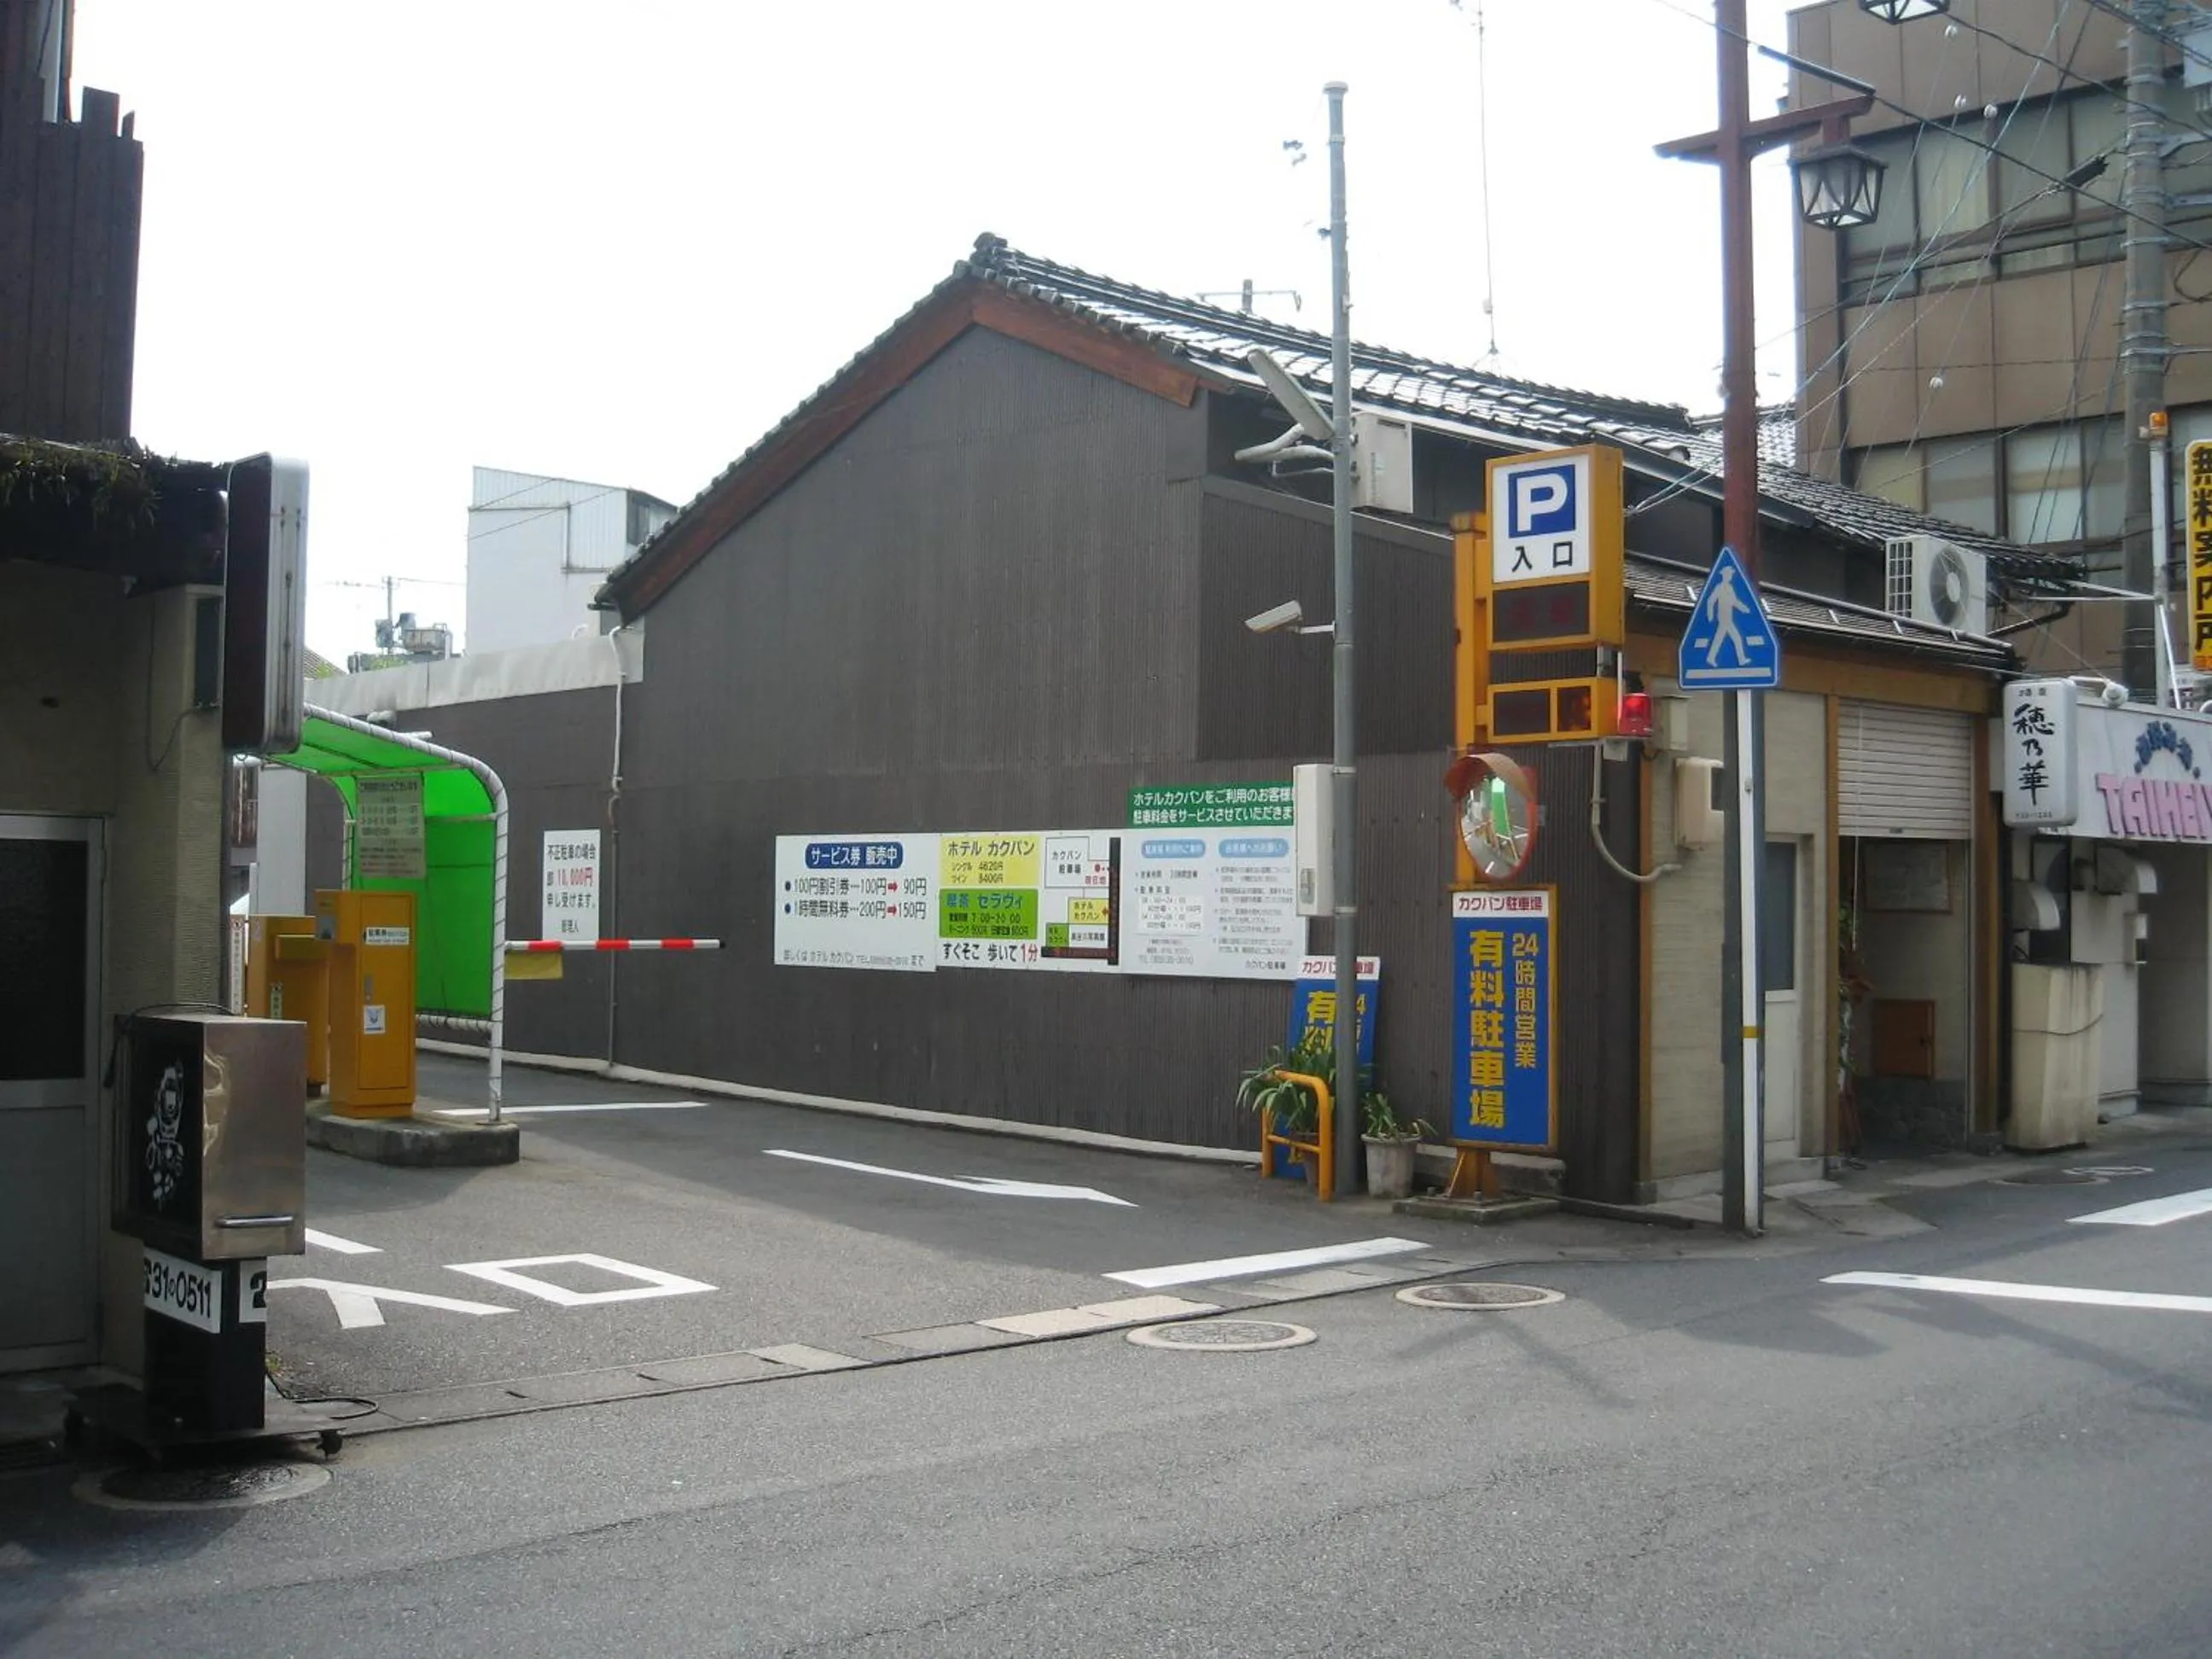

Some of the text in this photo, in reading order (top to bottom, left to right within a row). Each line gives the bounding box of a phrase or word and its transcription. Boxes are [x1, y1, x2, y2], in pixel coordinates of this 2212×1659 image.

[1516, 473, 1569, 533] P
[1511, 540, 1573, 573] 入口
[1133, 787, 1294, 806] ホテルカクバンをご利用のお客様
[547, 843, 596, 860] 不正駐車の場合
[811, 846, 898, 865] サービス券 販売中
[948, 841, 1035, 858] ホテル カクバン
[1051, 850, 1082, 861] カクバン
[951, 862, 973, 871] シングル
[1058, 864, 1081, 874] 駐車場
[903, 876, 927, 896] 90円
[951, 875, 968, 884] ツイン
[899, 901, 927, 920] 150円
[947, 894, 1022, 909] 喫茶 セラヴィ
[1074, 901, 1093, 911] ホテル
[1458, 895, 1543, 913] カクバン駐車場
[943, 943, 1039, 963] すぐそこ 歩いて1分
[1512, 932, 1540, 1069] 24時間営業
[1468, 929, 1506, 1130] 有料駐車場
